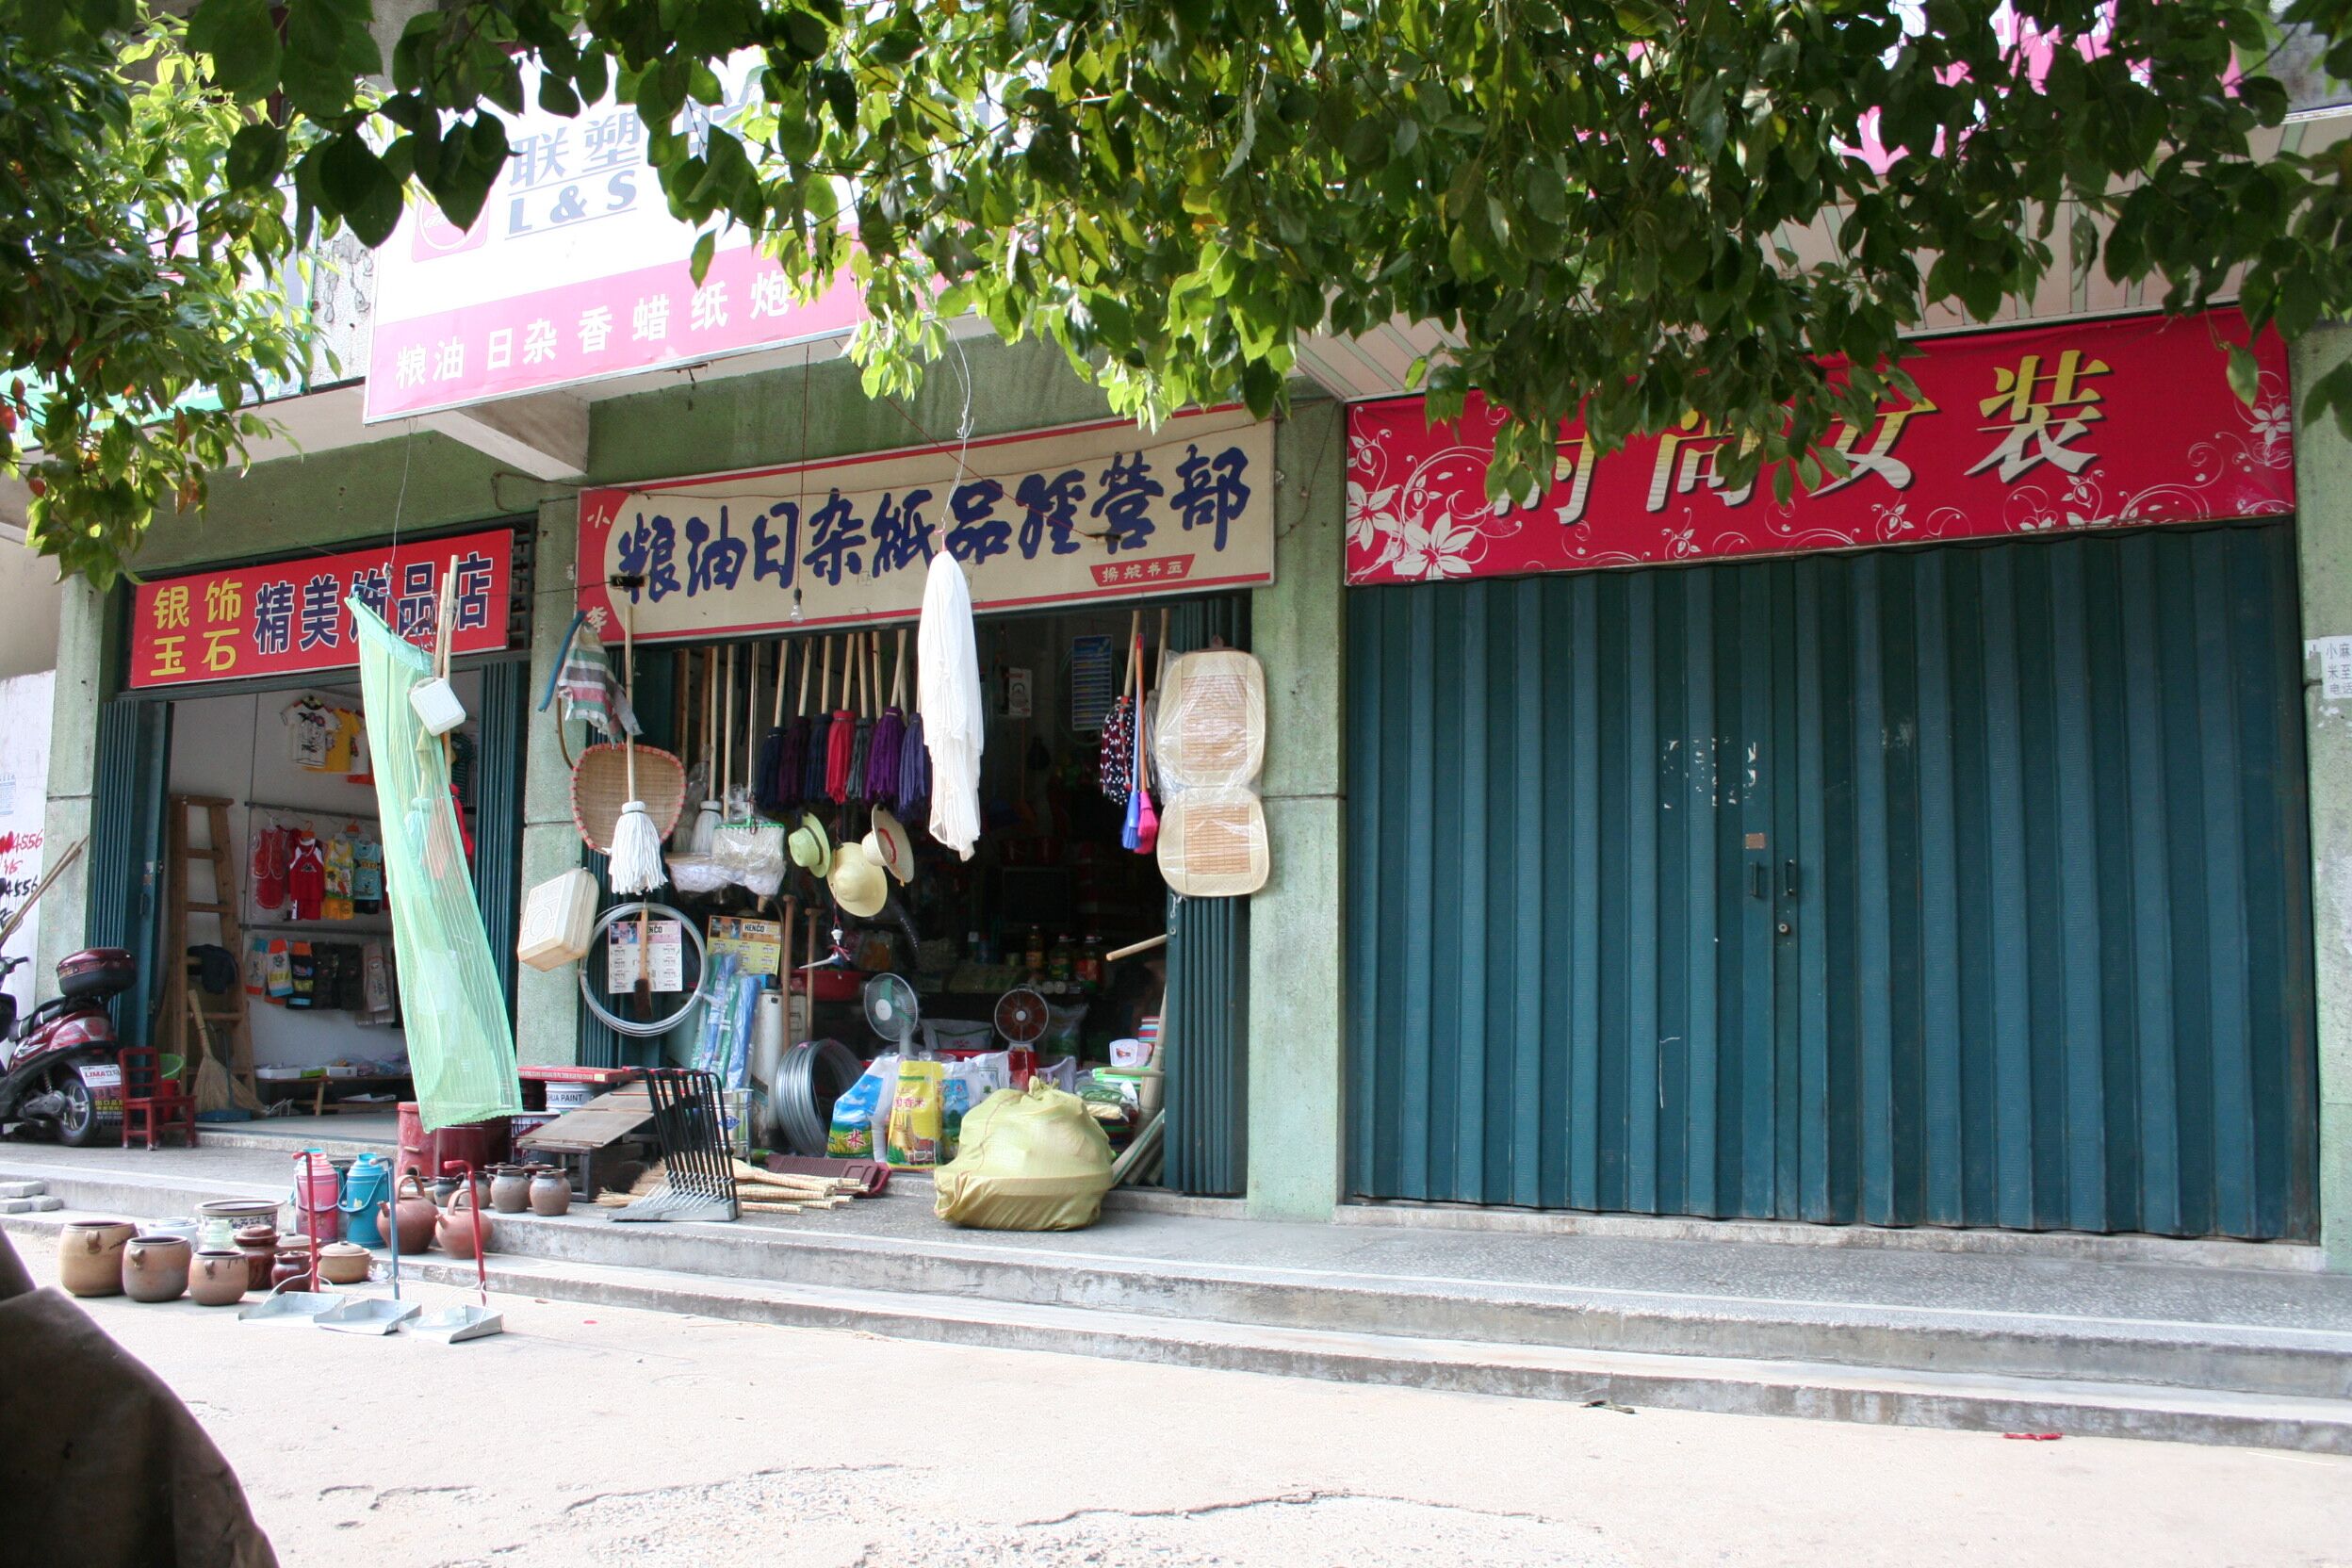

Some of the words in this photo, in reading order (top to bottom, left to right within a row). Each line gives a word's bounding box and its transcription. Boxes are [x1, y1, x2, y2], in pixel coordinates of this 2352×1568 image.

[509, 110, 643, 188] 联塑
[150, 628, 240, 677] 玉石
[561, 1093, 583, 1102] PAINT
